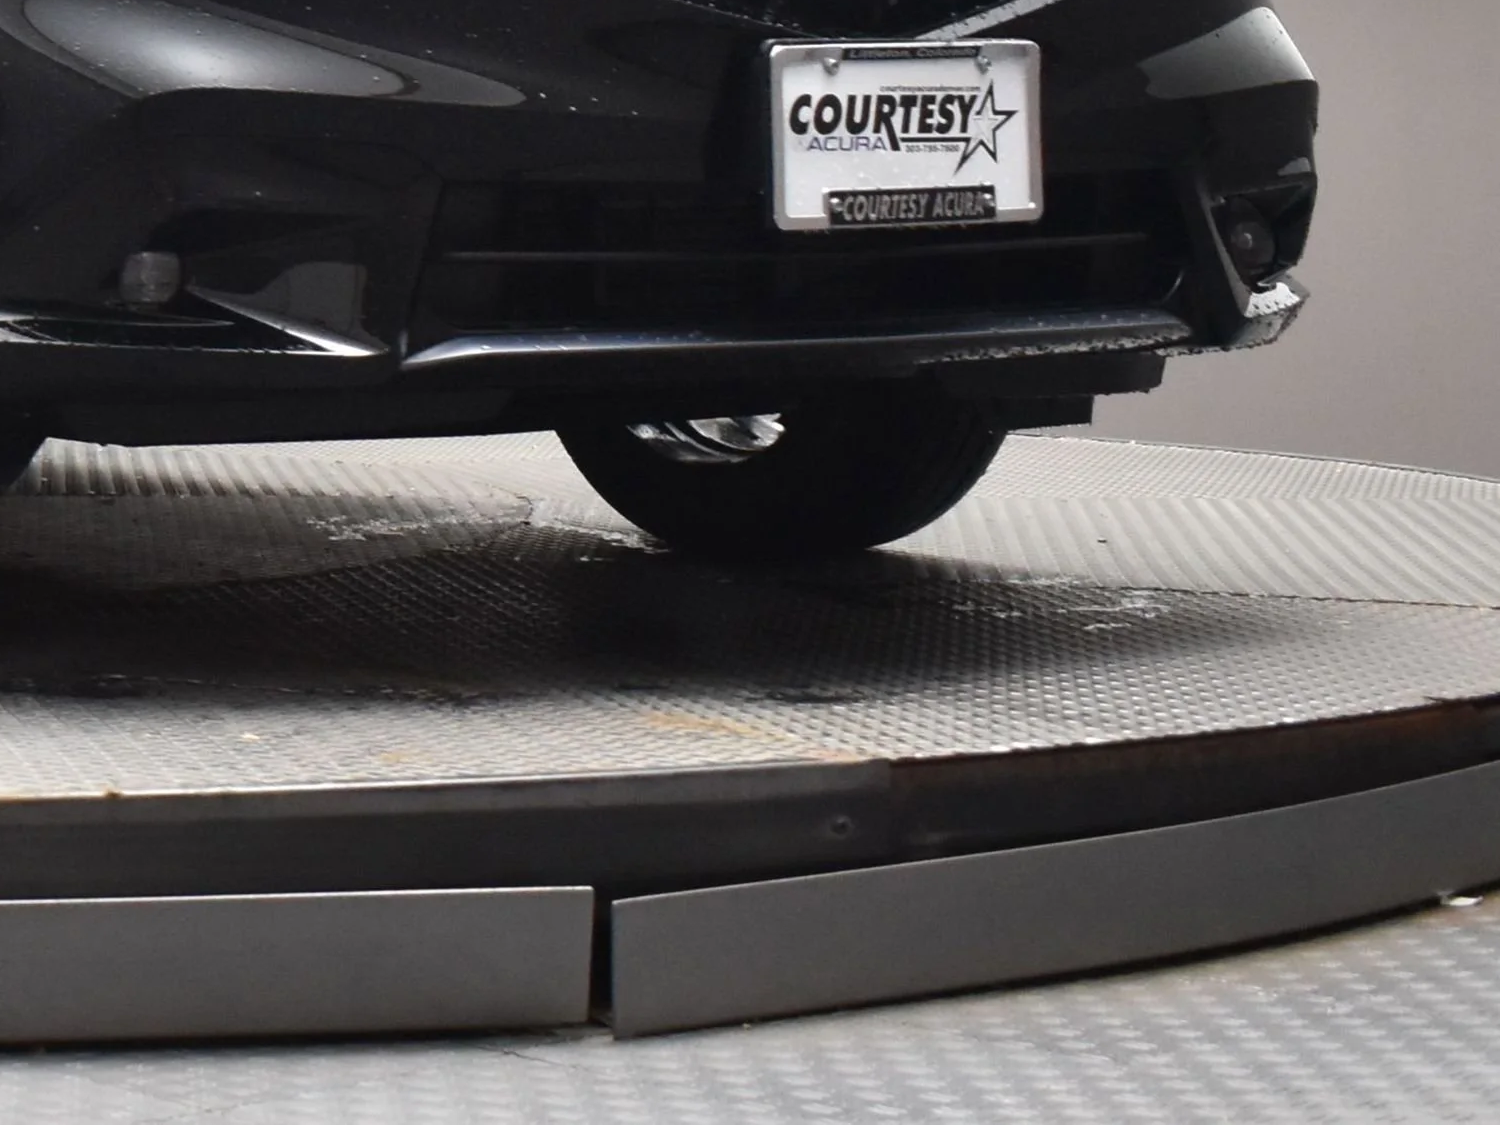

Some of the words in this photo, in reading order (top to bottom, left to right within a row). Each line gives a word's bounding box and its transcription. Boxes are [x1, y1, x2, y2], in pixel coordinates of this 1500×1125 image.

[789, 93, 977, 151] COURTESY
[807, 135, 887, 152] ACURA
[843, 194, 930, 221] COURTESY
[932, 190, 985, 216] ACURA
